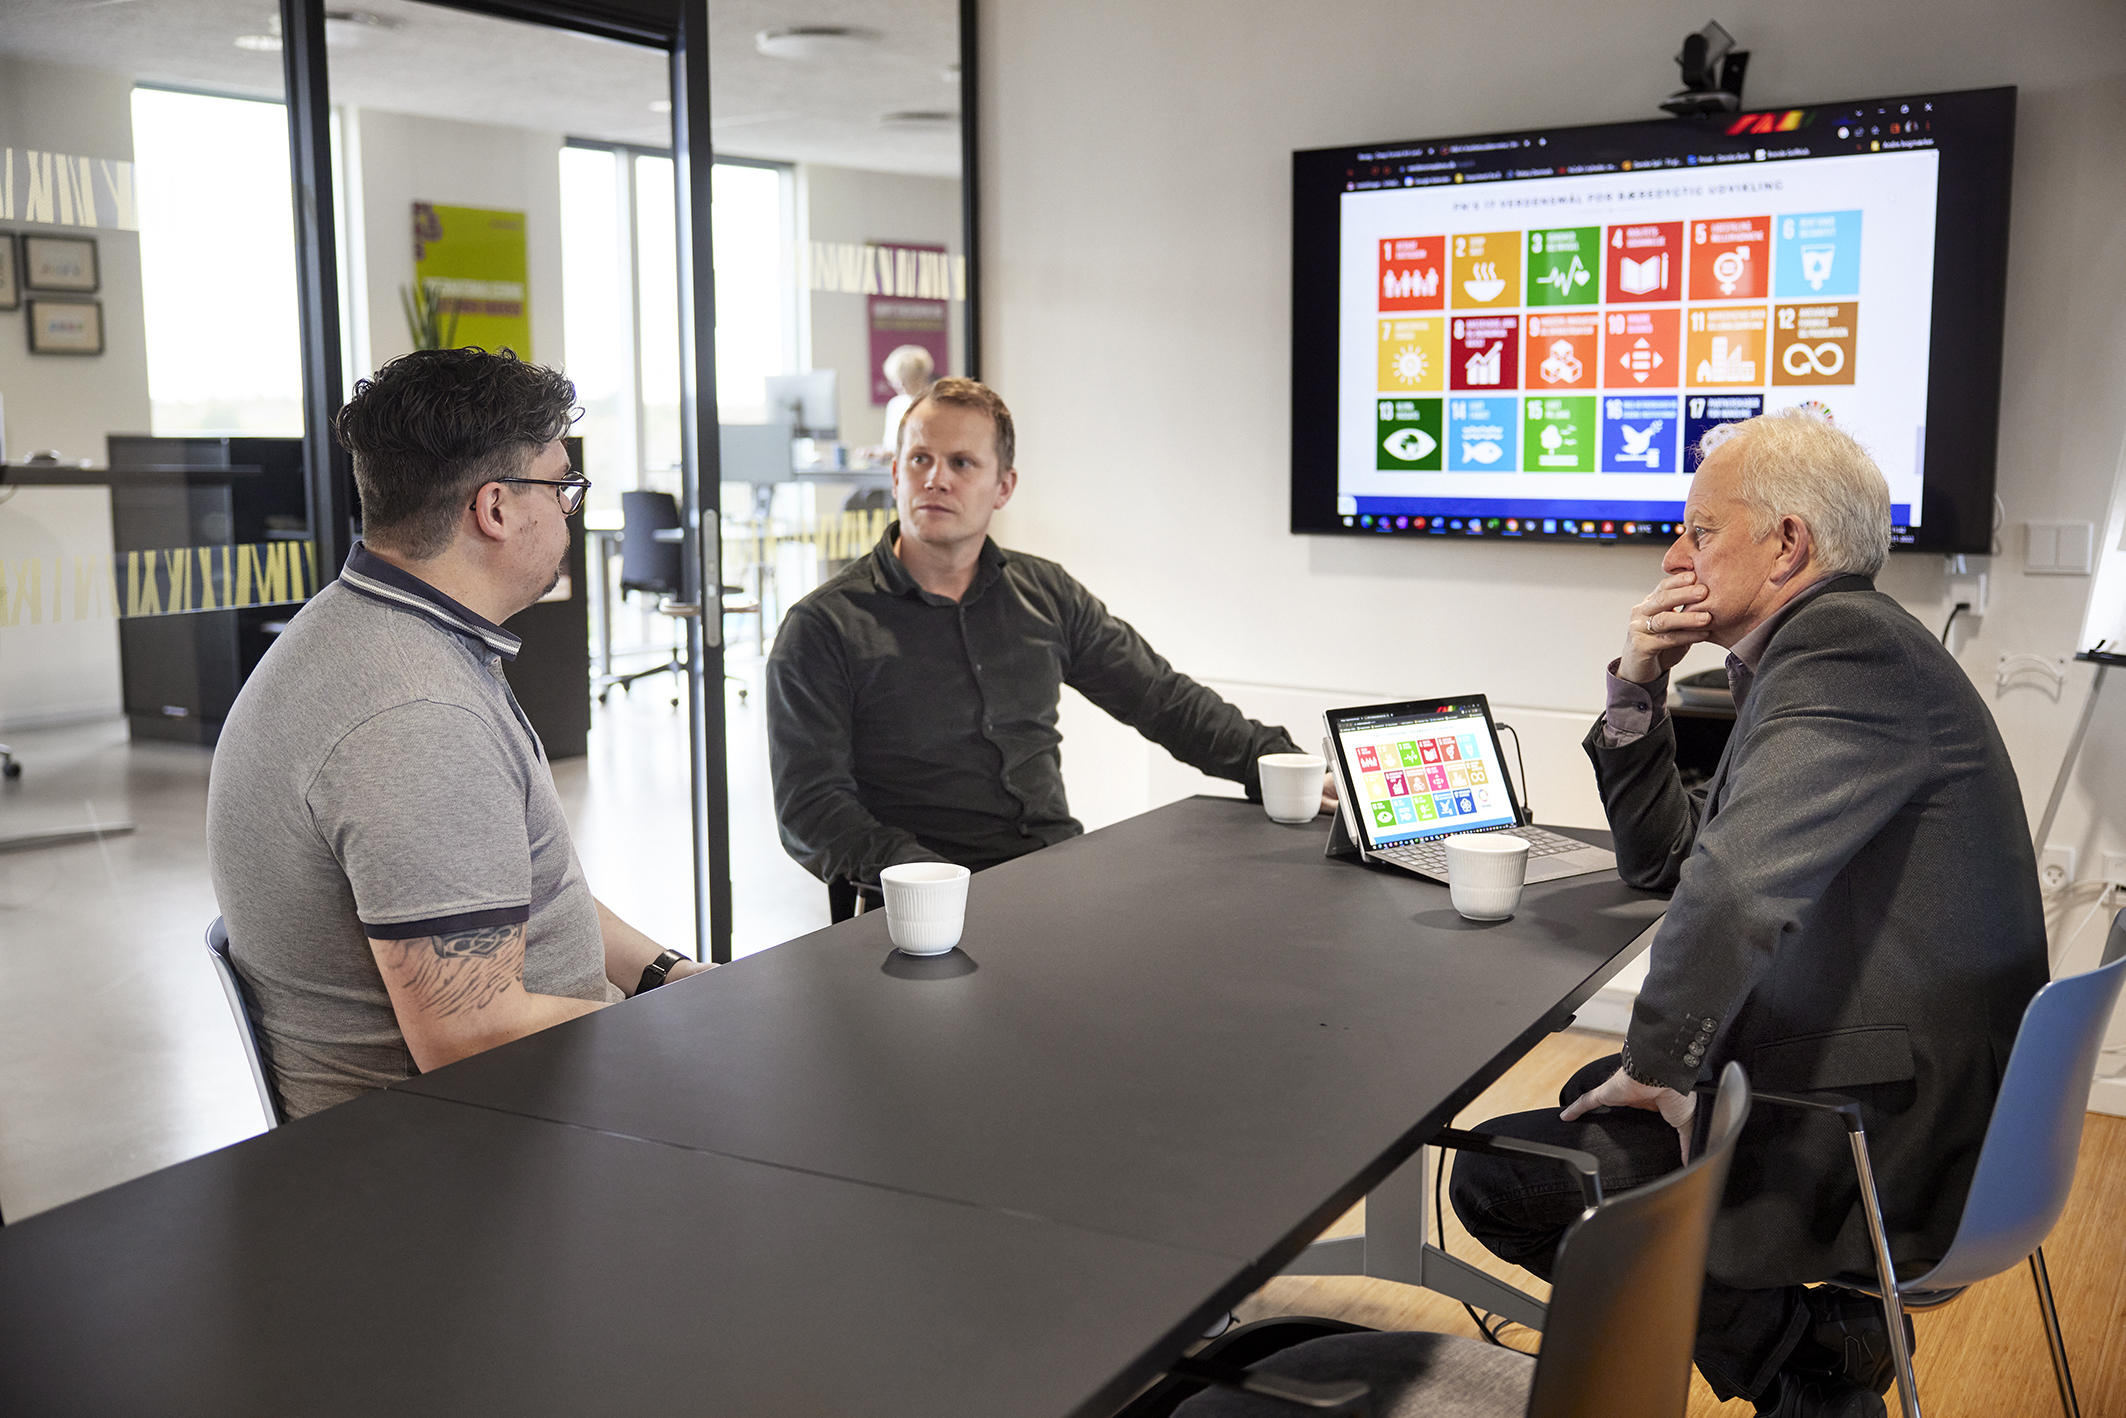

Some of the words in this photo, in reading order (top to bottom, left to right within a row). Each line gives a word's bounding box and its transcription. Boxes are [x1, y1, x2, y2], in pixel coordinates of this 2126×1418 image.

[1611, 228, 1624, 249] 4
[1695, 223, 1707, 245] 5
[1783, 218, 1795, 240] 6
[1384, 241, 1393, 261] 1
[1455, 237, 1467, 257] 2
[1531, 233, 1543, 254] 3
[1529, 316, 1541, 337] 9
[1607, 313, 1626, 335] 10
[1691, 311, 1705, 332] 11
[1778, 307, 1795, 330] 12
[1382, 321, 1392, 341] 7
[1453, 319, 1465, 340] 8
[1379, 401, 1394, 421] 13
[1451, 401, 1467, 421] 14
[1527, 400, 1543, 420] 15
[1689, 397, 1706, 419] 17
